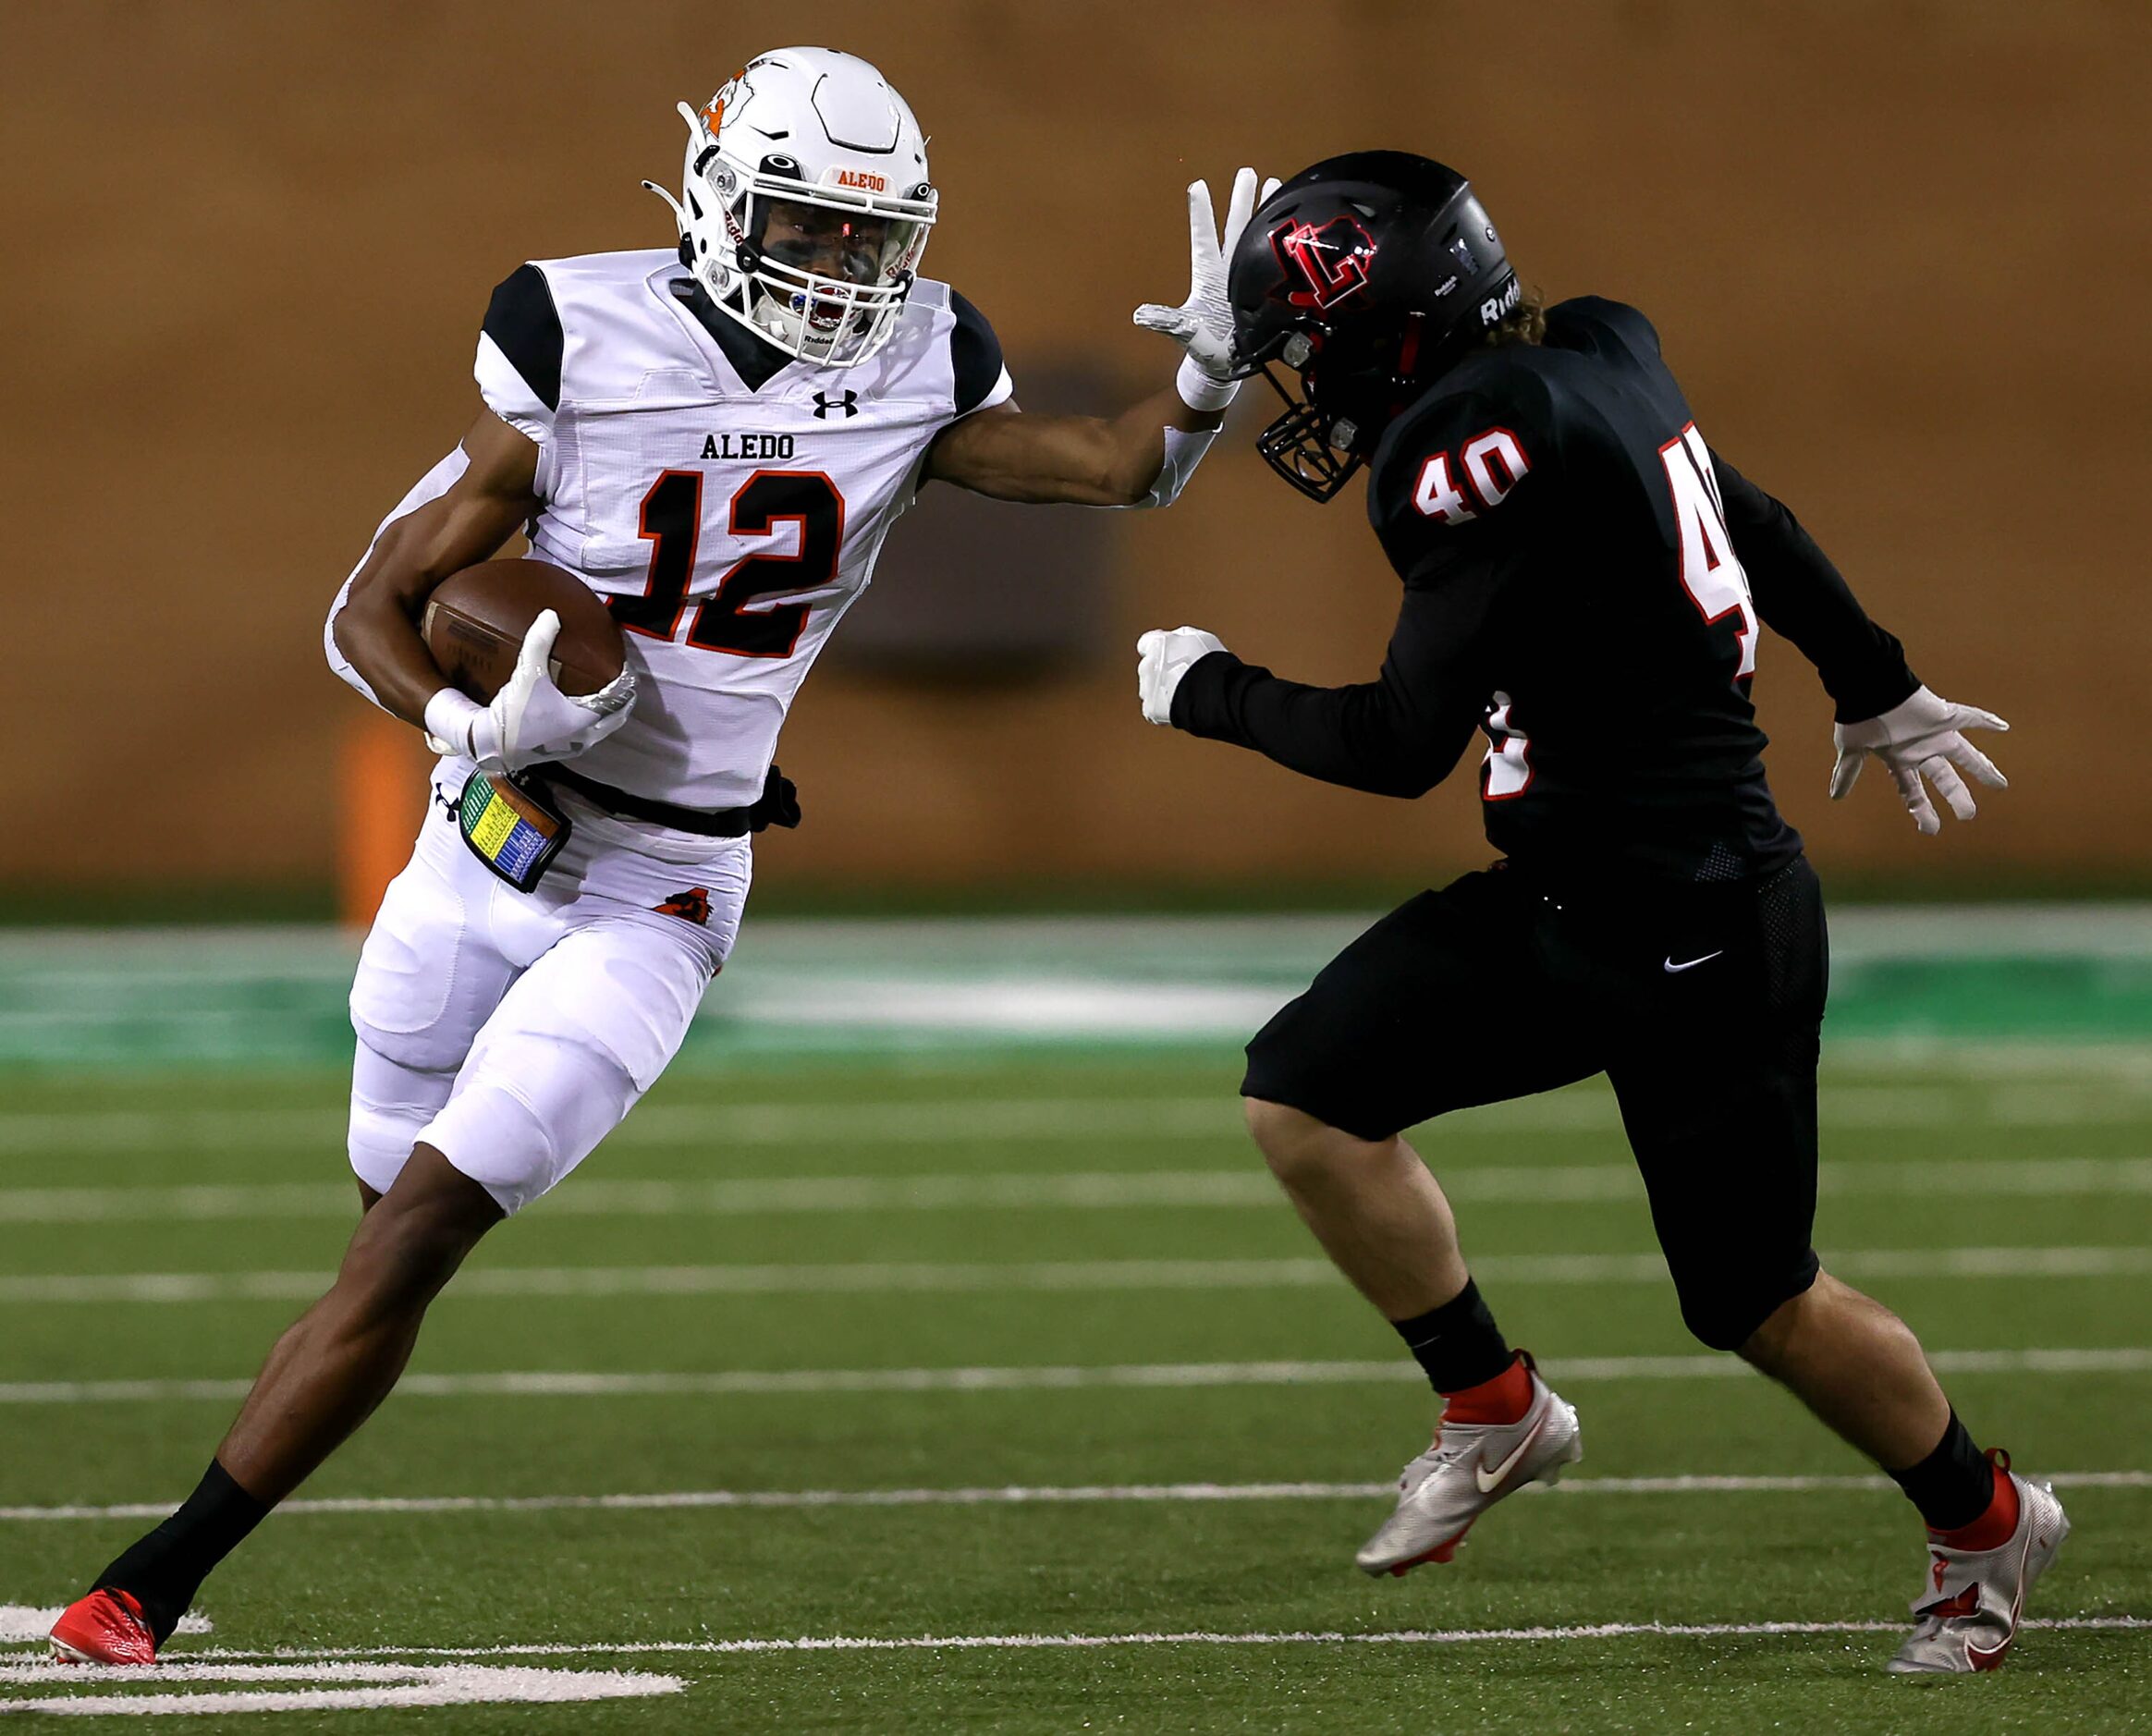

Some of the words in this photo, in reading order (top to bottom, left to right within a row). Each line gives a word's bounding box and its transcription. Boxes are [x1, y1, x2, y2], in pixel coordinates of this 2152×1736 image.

[838, 170, 885, 191] ALEDO
[700, 434, 794, 459] ALEDO
[1412, 425, 1533, 526] 40
[605, 469, 845, 658] 12
